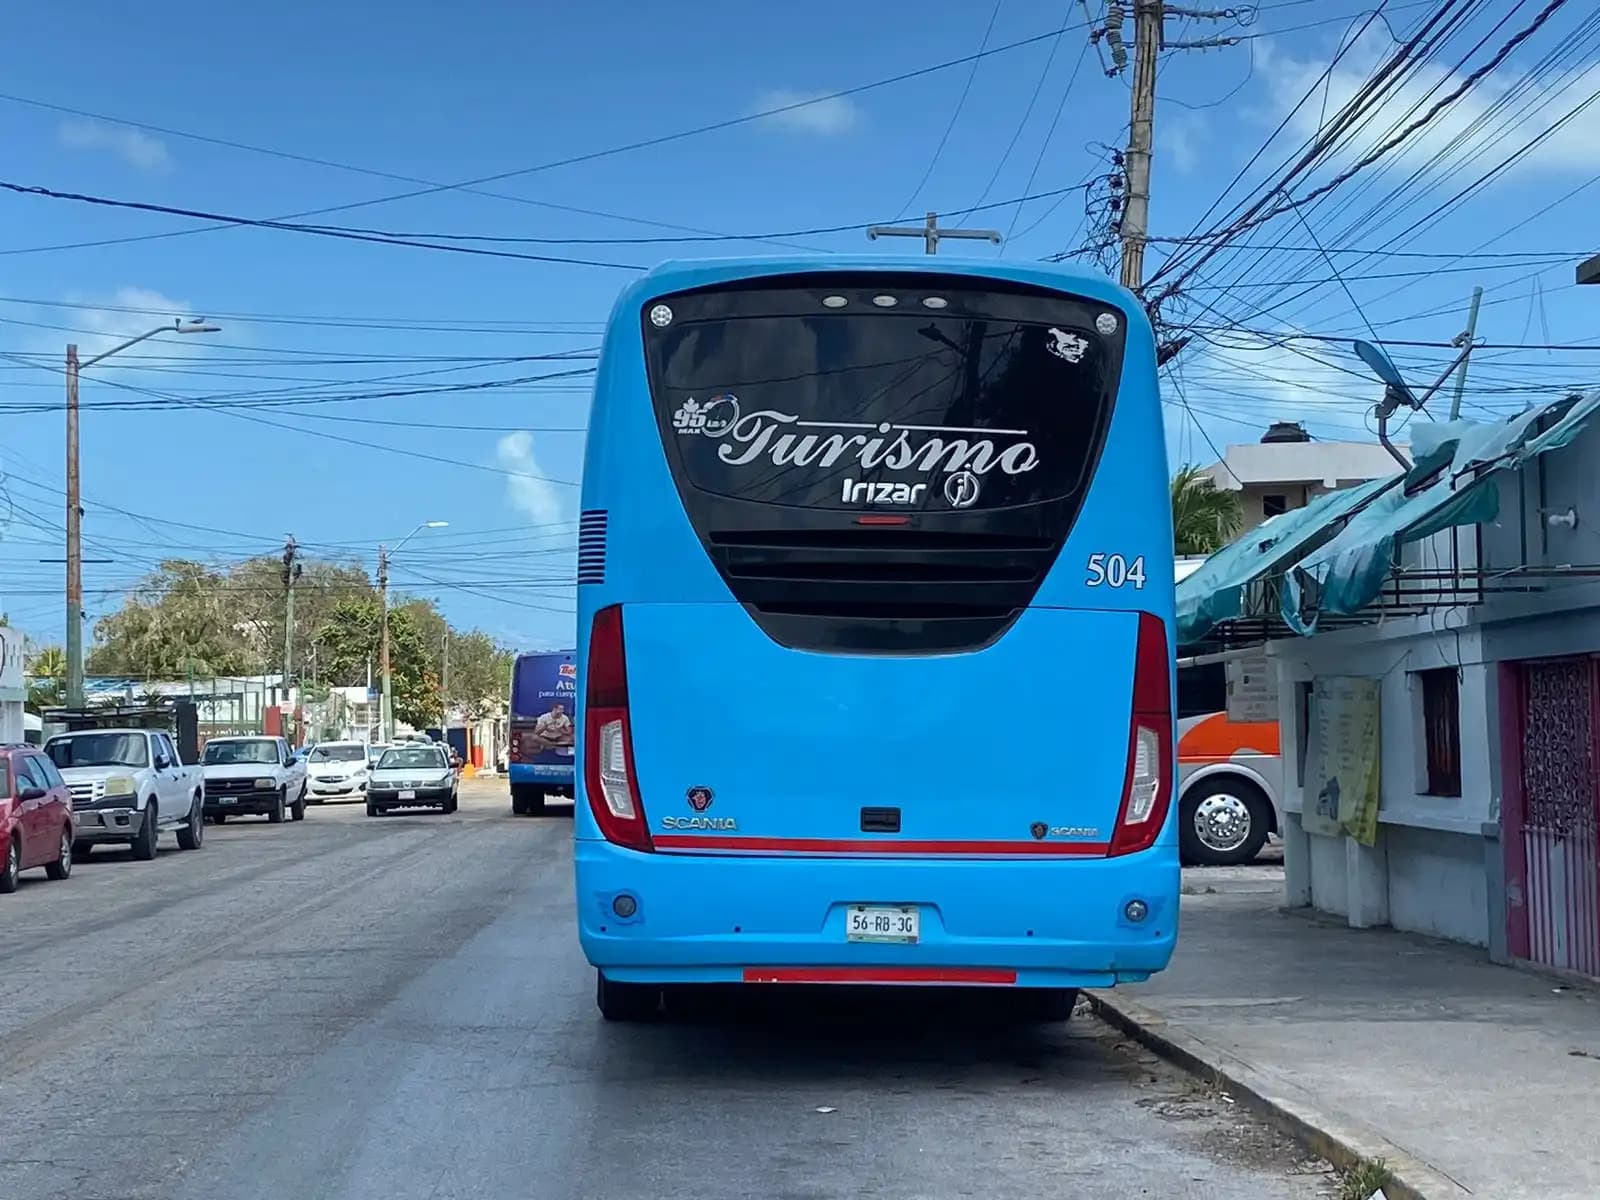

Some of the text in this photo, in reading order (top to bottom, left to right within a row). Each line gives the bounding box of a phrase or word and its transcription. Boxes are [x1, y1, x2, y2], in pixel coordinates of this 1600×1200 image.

[672, 408, 707, 428] 95
[718, 409, 1040, 475] Turismo
[842, 477, 927, 504] Irizar
[1086, 553, 1146, 590] 504
[661, 815, 738, 831] SCANIA
[1050, 826, 1098, 836] SCANIA
[852, 914, 914, 933] 56-RB-3G
